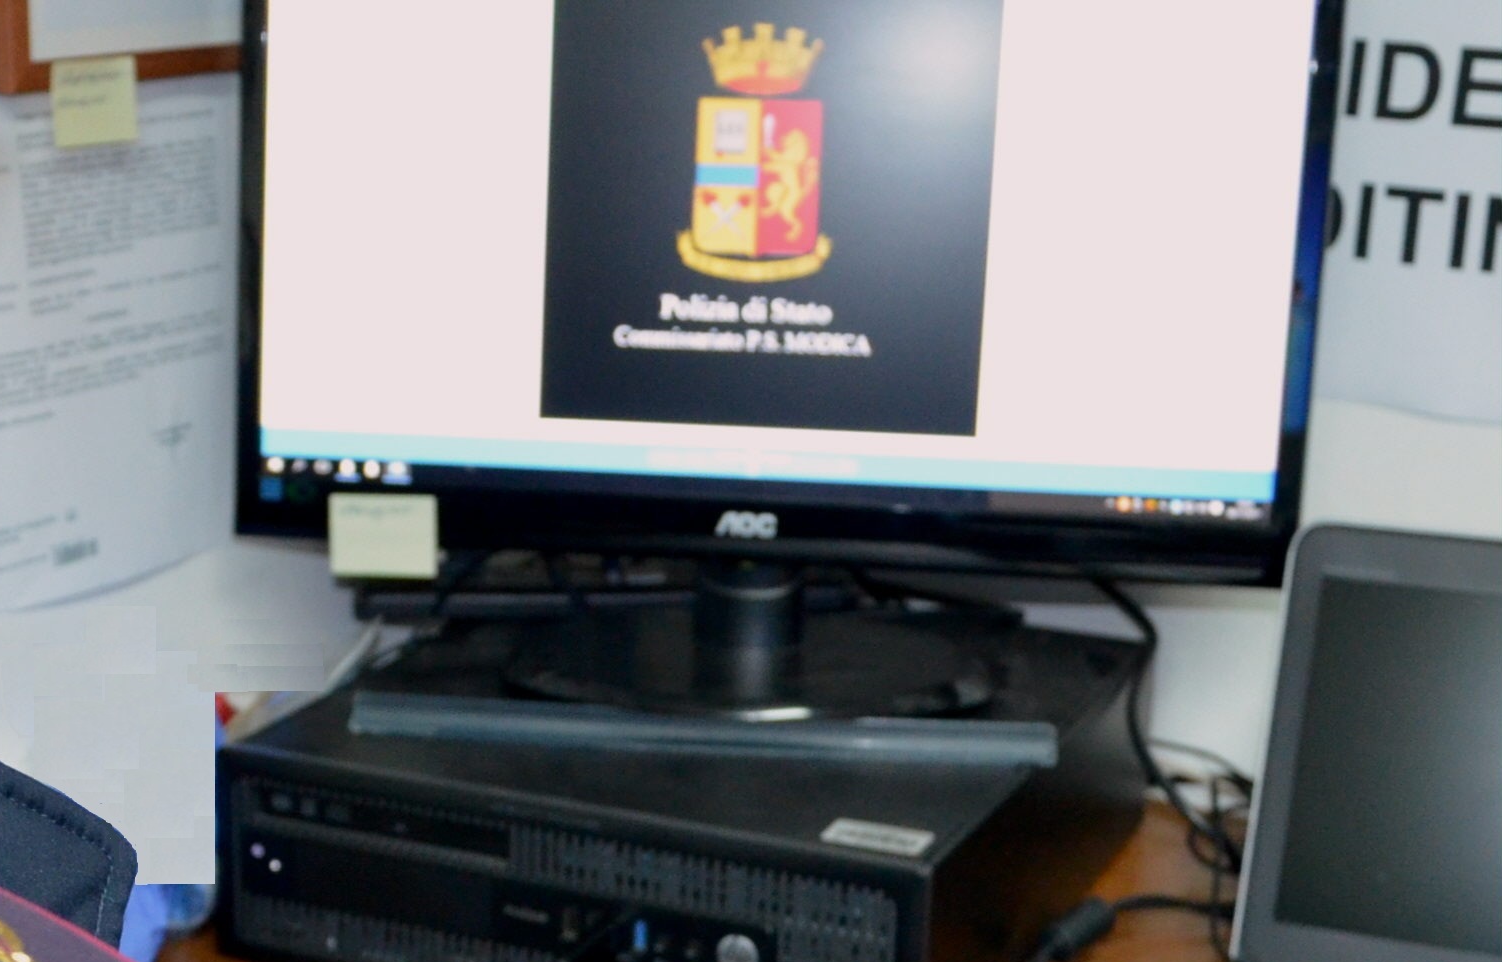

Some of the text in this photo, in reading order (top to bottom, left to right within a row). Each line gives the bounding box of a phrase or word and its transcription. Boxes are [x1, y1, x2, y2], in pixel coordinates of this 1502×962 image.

[659, 293, 834, 326] Polizia di Stato
[783, 331, 873, 357] MODICA
[714, 510, 778, 539] AOC
